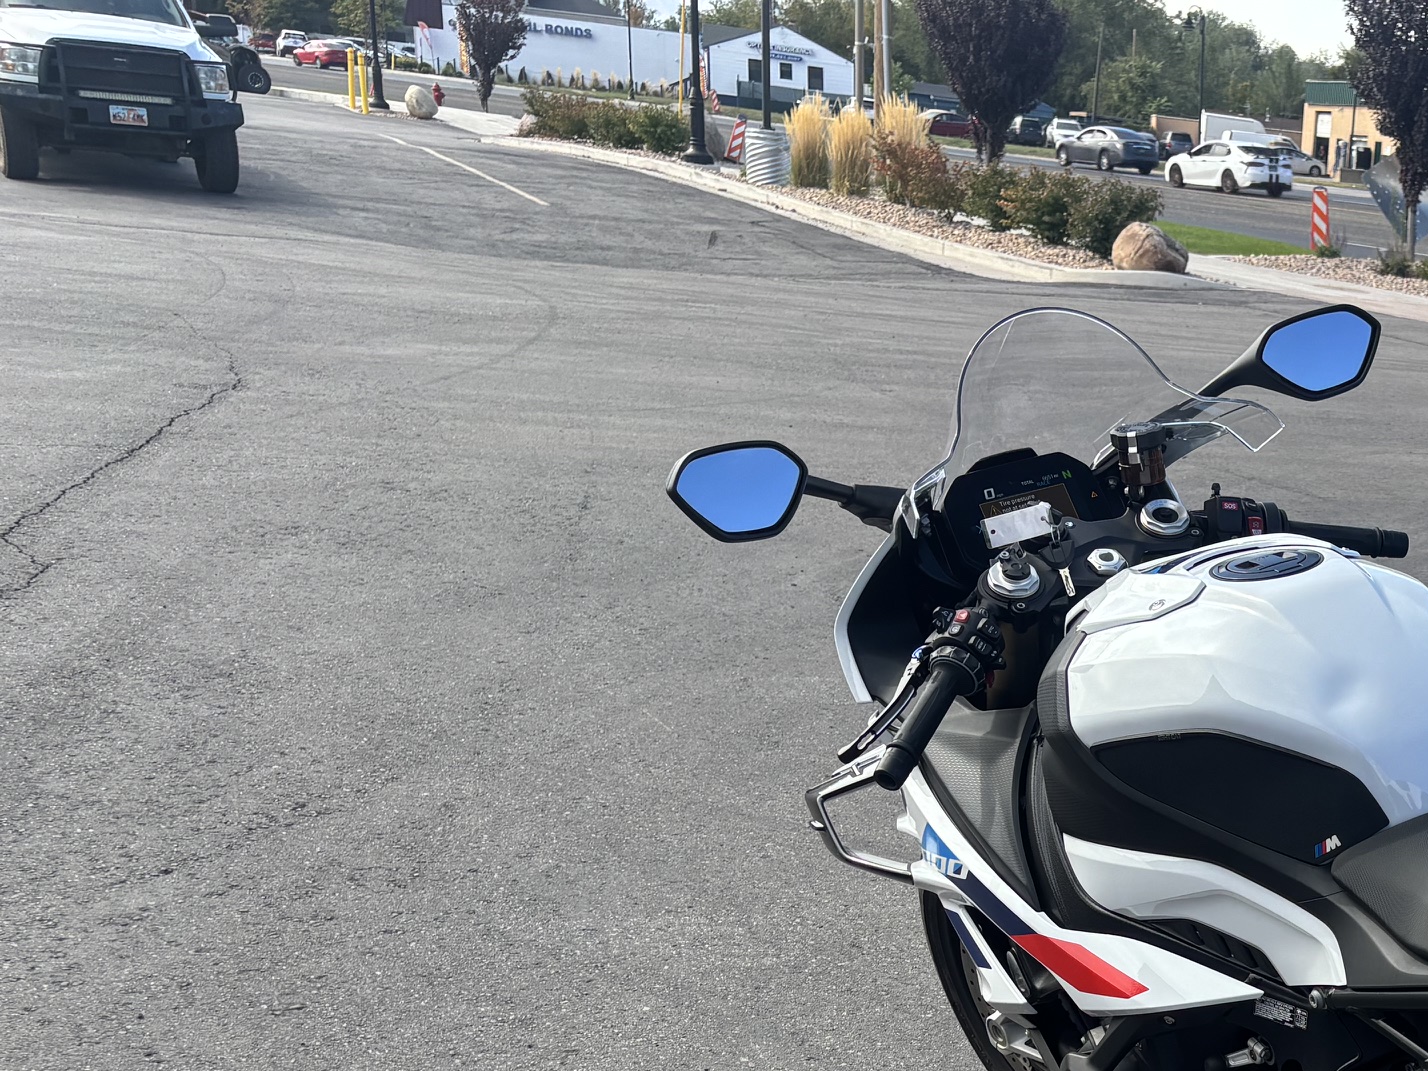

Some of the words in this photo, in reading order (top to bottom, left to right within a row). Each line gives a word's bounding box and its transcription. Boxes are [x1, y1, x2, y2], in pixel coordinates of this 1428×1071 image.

[545, 24, 592, 38] BONDS
[1061, 469, 1072, 479] N
[999, 497, 1011, 507] Tire
[1011, 494, 1036, 506] pressure
[1223, 502, 1237, 510] SOS
